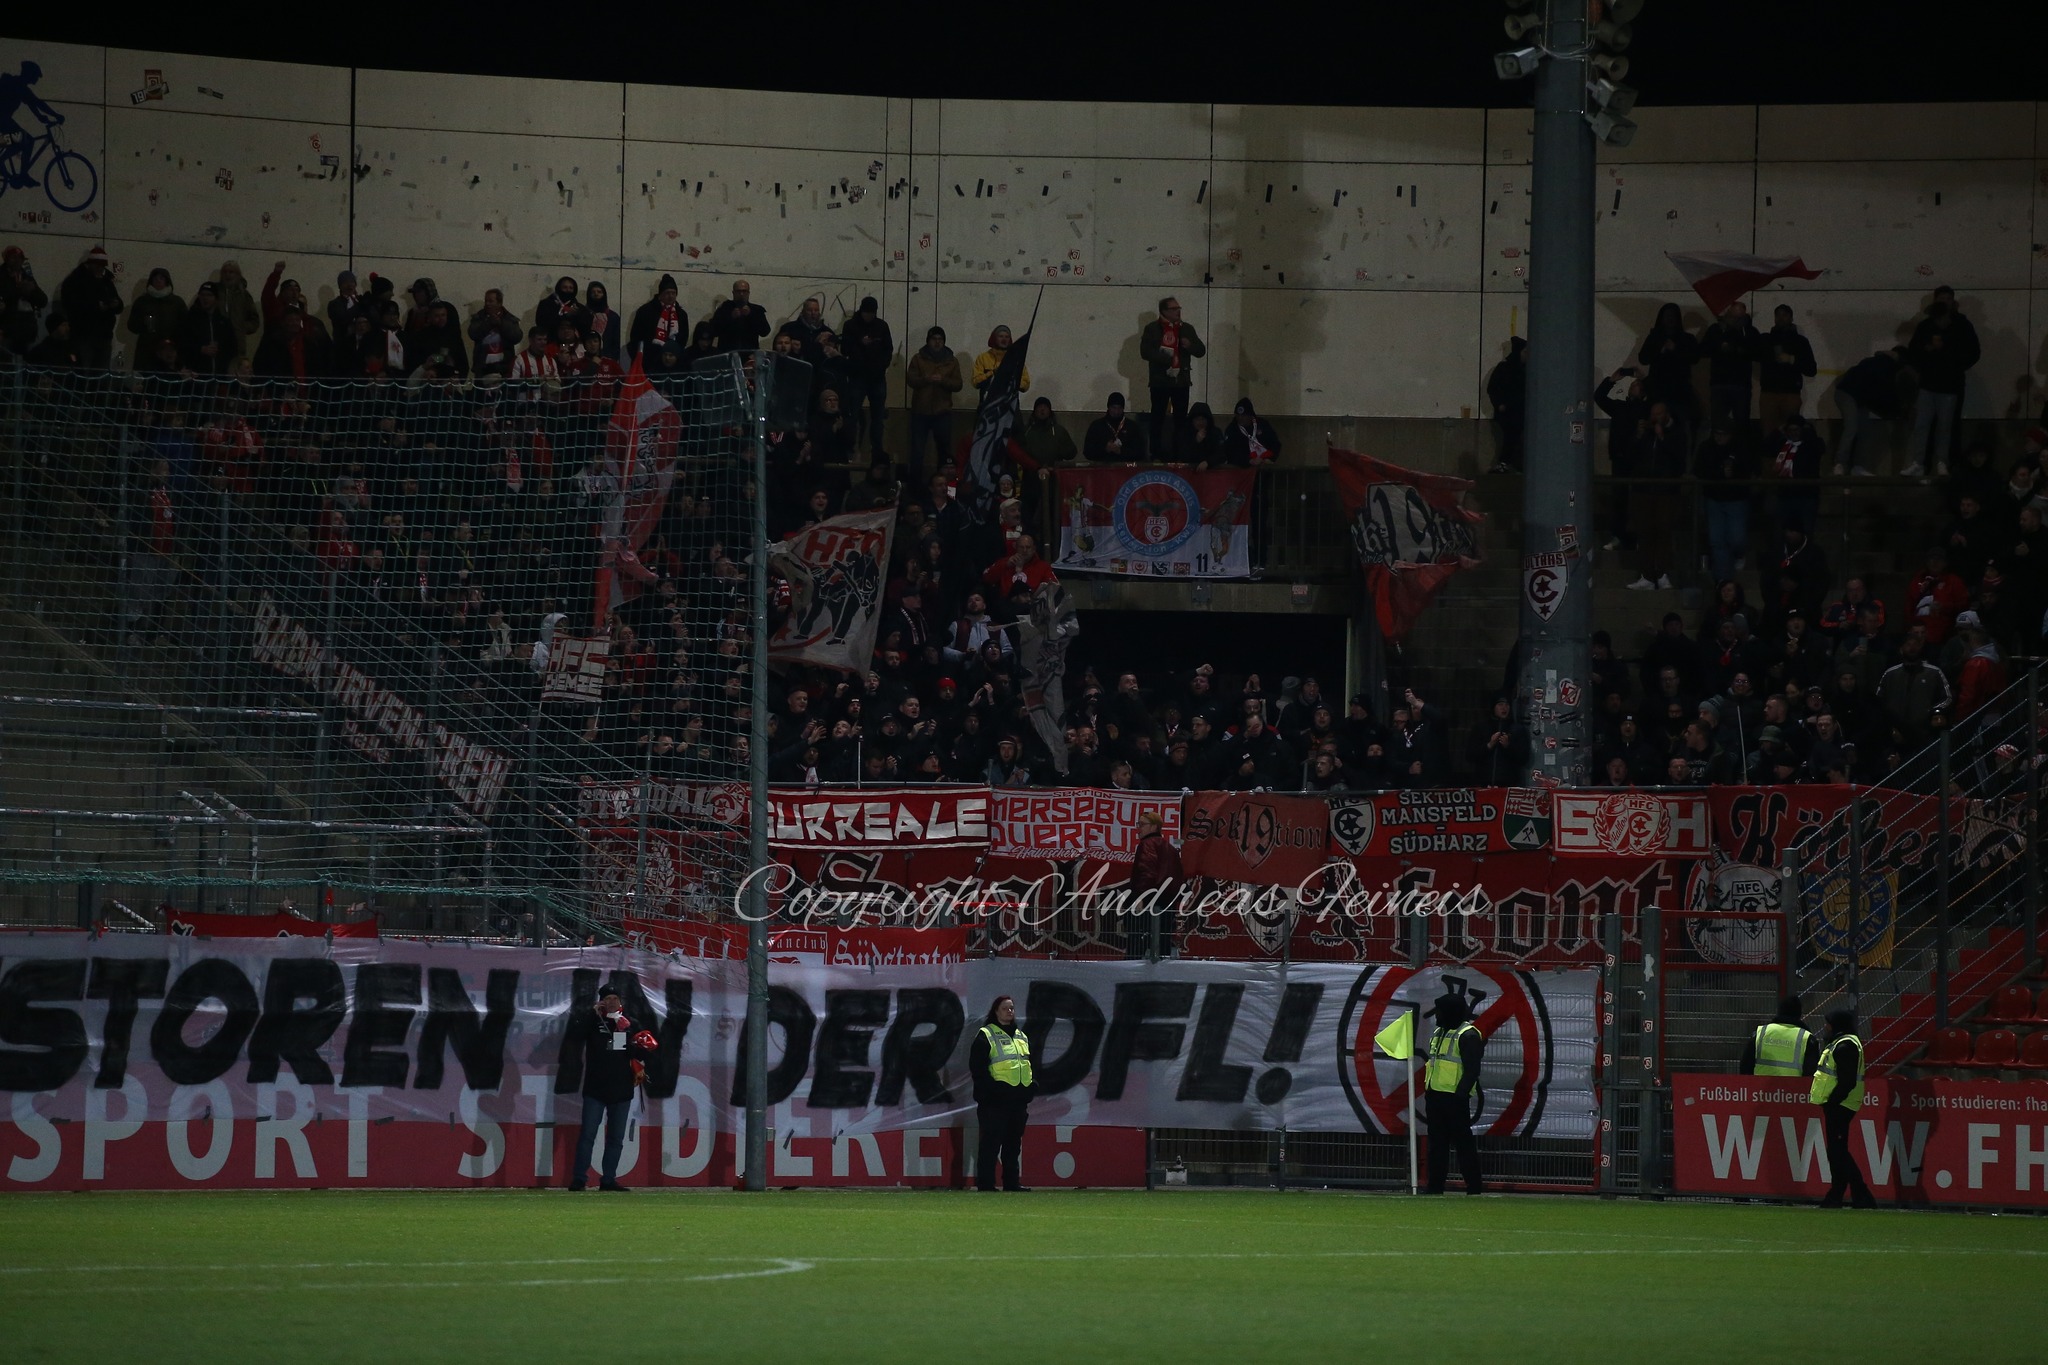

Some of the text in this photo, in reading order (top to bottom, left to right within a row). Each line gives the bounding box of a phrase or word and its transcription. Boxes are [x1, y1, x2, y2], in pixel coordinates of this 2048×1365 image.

[1195, 553, 1208, 572] 11
[549, 638, 610, 677] HFC
[545, 672, 604, 695] CHEMIE
[1052, 789, 1113, 799] SEKTION
[1399, 788, 1476, 806] SEKTION
[1629, 799, 1655, 810] HFC
[1381, 804, 1497, 825] MANSFELD
[1390, 831, 1488, 855] SÜDHARZ
[1736, 882, 1760, 893] HFC
[730, 984, 965, 1108] DER
[1700, 1087, 1748, 1102] Fußball
[1863, 1090, 1879, 1106] de
[1911, 1094, 1947, 1110] Sport
[1951, 1095, 2021, 1111] studieren:
[7, 1075, 384, 1183] SPORT
